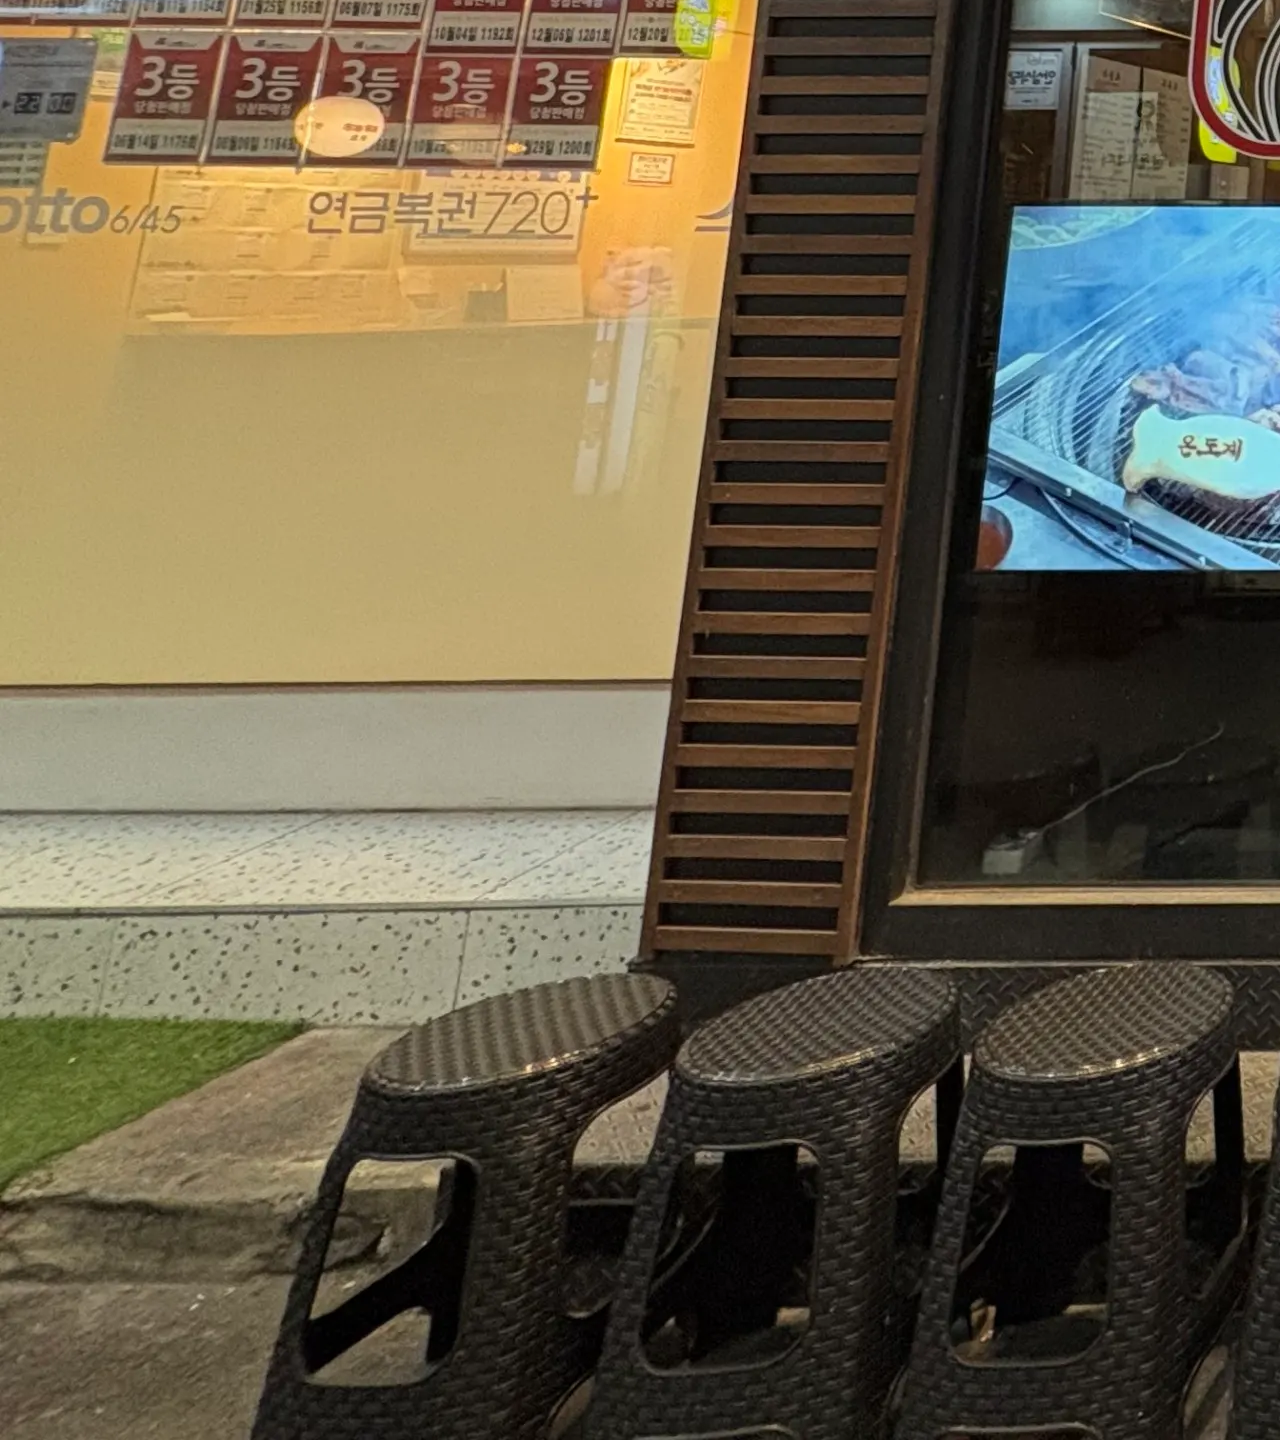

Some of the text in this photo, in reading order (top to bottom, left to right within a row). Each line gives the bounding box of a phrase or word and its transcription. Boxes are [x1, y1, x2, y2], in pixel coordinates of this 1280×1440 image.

[134, 56, 199, 100] 3등
[235, 58, 300, 102] 3등
[337, 60, 400, 103] 3등
[433, 61, 495, 104] 3등
[530, 61, 592, 105] 3등
[1177, 435, 1243, 462] 온도계
